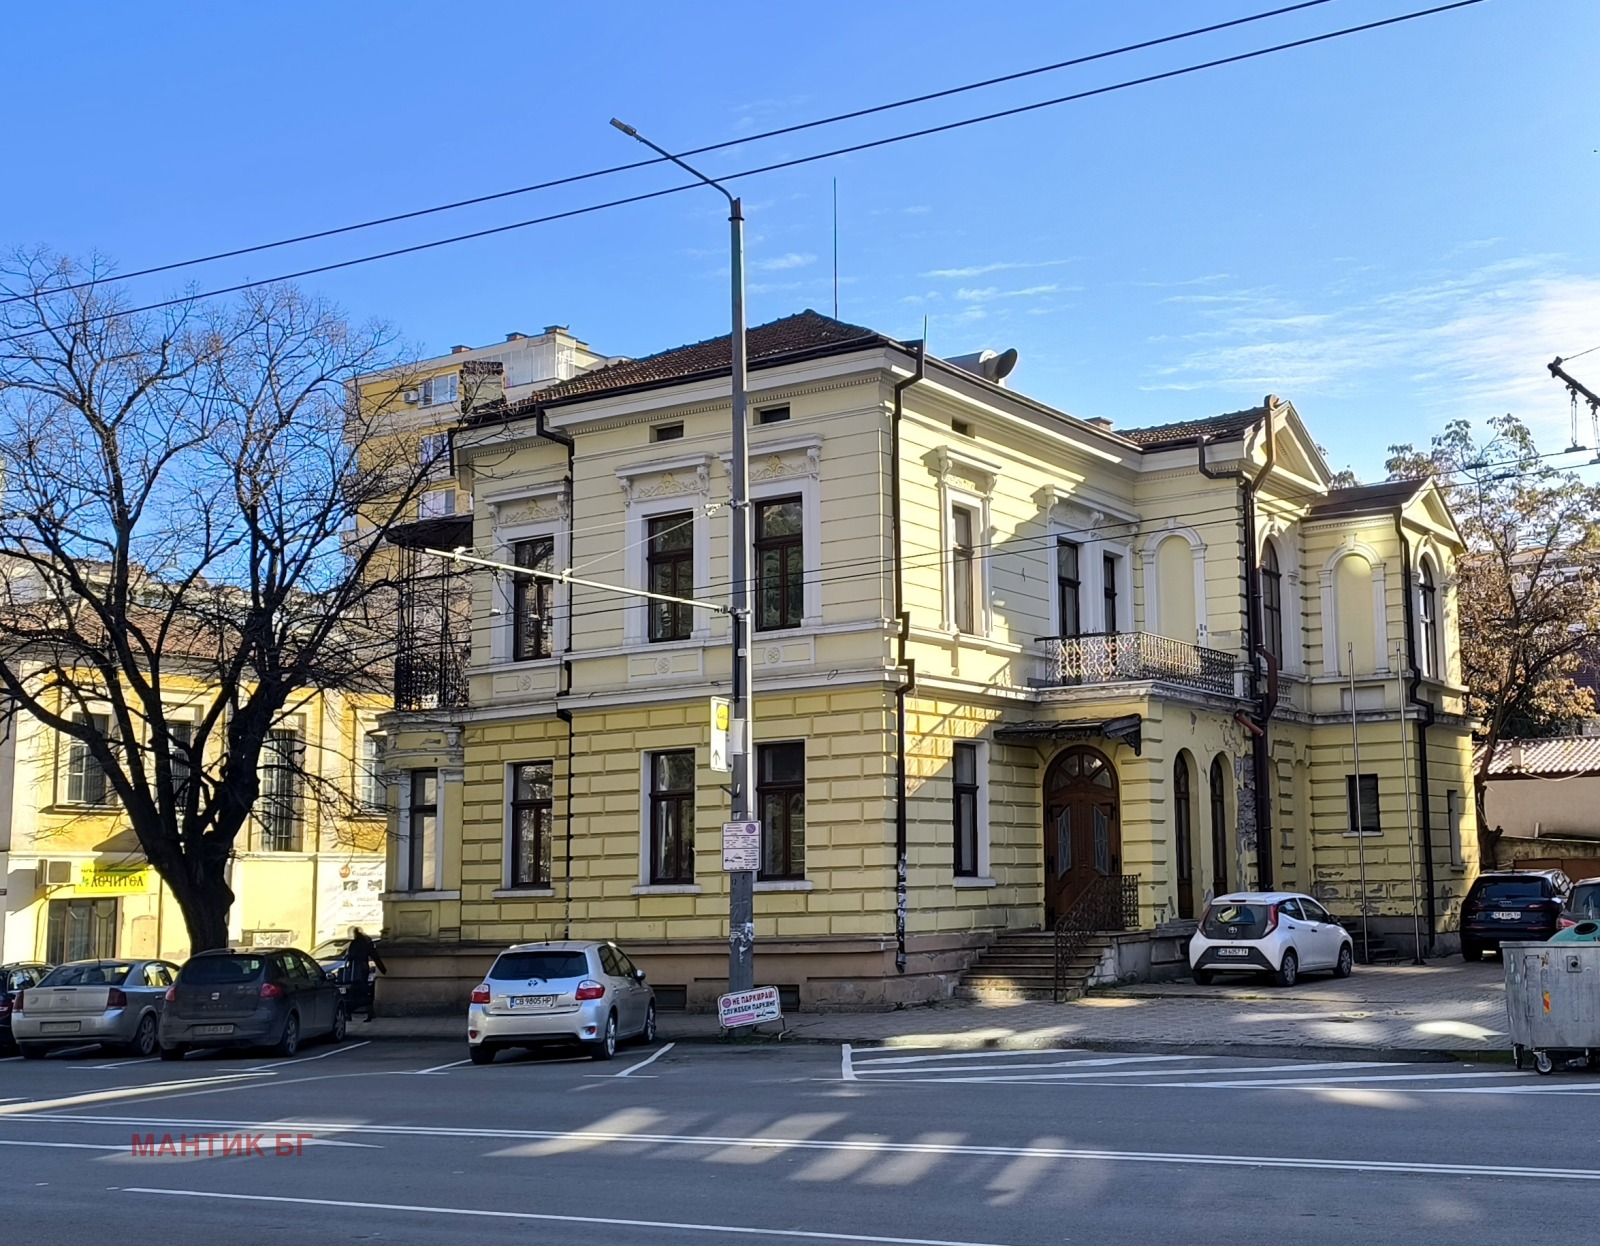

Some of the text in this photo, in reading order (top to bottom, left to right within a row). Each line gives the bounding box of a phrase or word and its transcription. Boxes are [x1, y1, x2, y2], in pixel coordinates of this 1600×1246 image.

[525, 997, 541, 1005] 9805
[732, 997, 740, 1006] НЕ
[722, 1005, 752, 1016] СЛУЖЕБЕН
